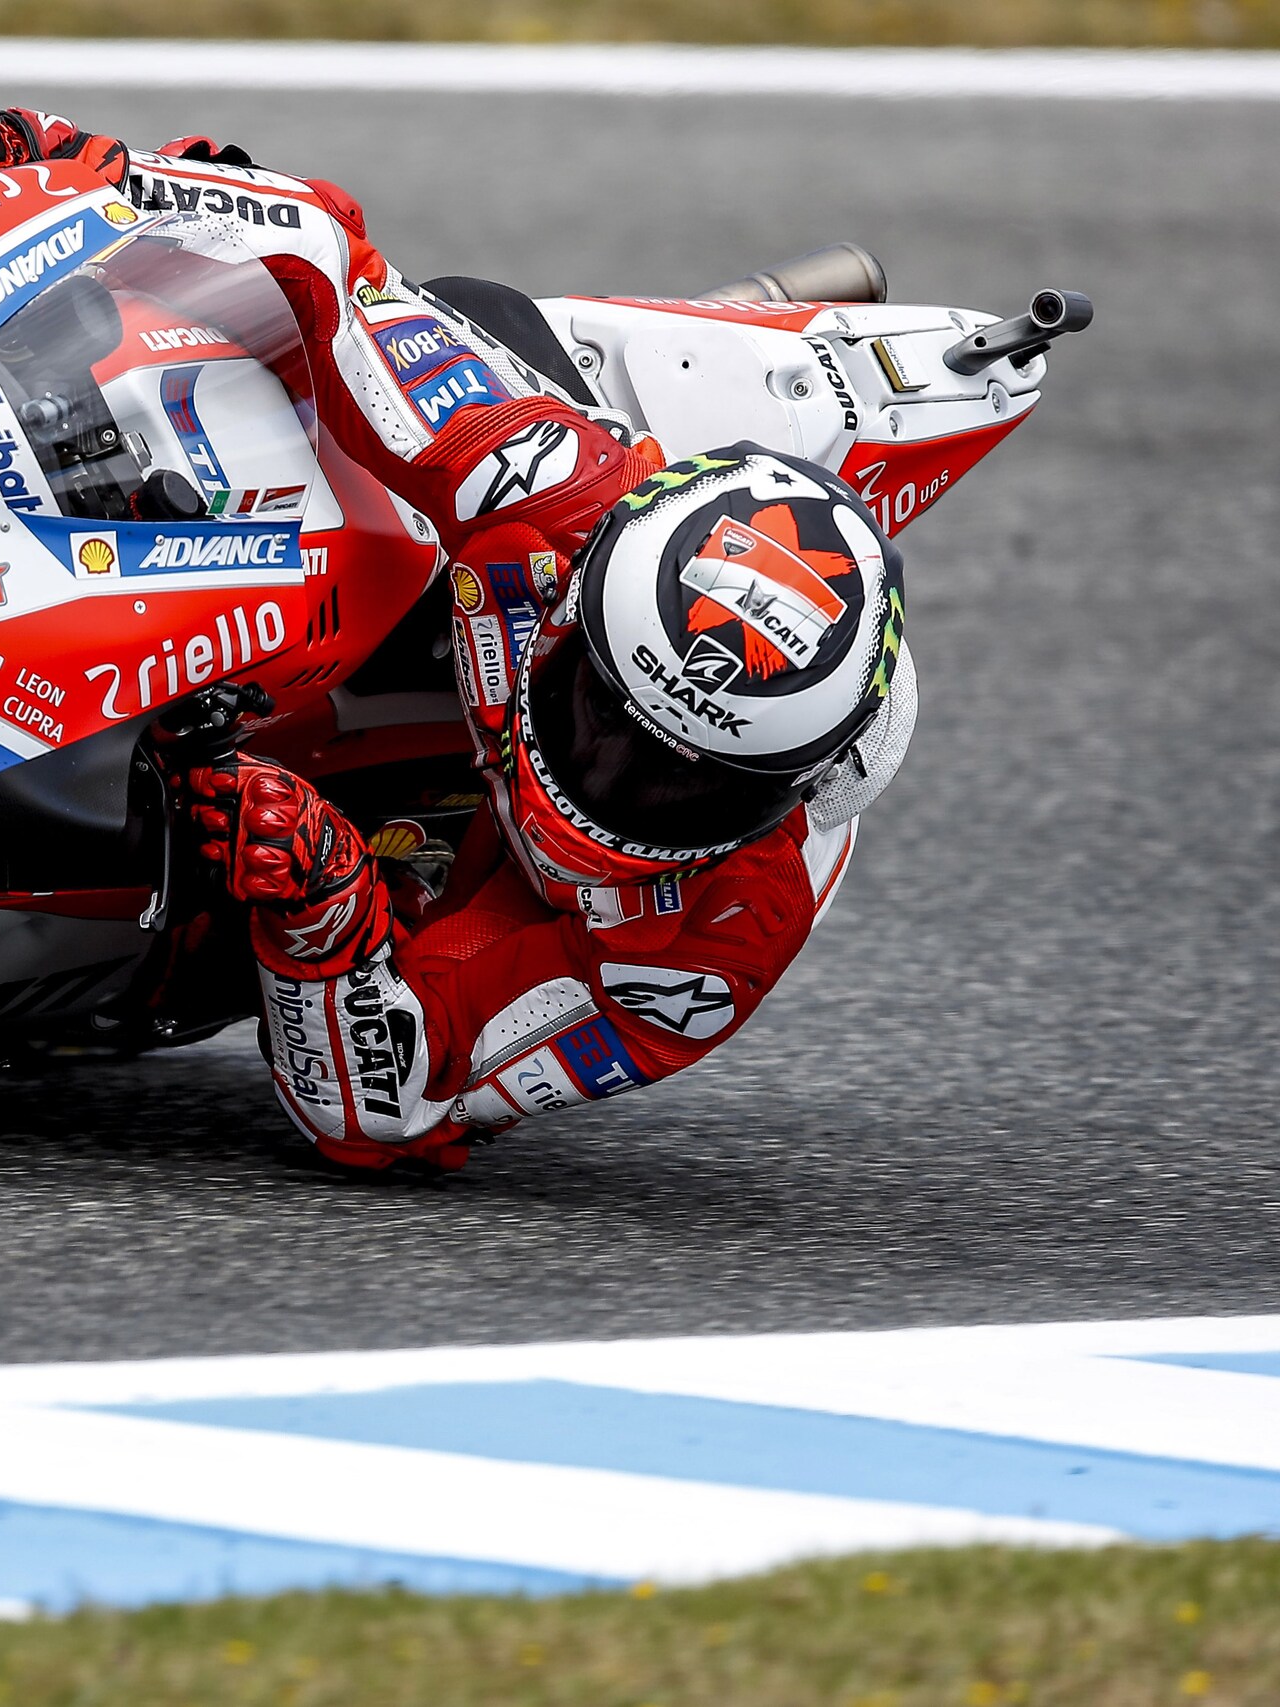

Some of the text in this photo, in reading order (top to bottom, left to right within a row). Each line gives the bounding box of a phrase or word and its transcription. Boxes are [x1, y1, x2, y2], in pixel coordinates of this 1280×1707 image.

[129, 174, 302, 229] DUCATI
[139, 327, 230, 352] DUCATI
[417, 368, 488, 424] TIM
[801, 336, 858, 431] DUCATI
[920, 469, 949, 504] ups
[139, 533, 290, 569] ADVANCE
[132, 600, 285, 709] riello
[482, 632, 502, 687] riello
[15, 668, 66, 707] LEON
[631, 644, 754, 739] SHARK
[3, 696, 65, 743] CUPRA
[269, 974, 331, 1107] nipolSai
